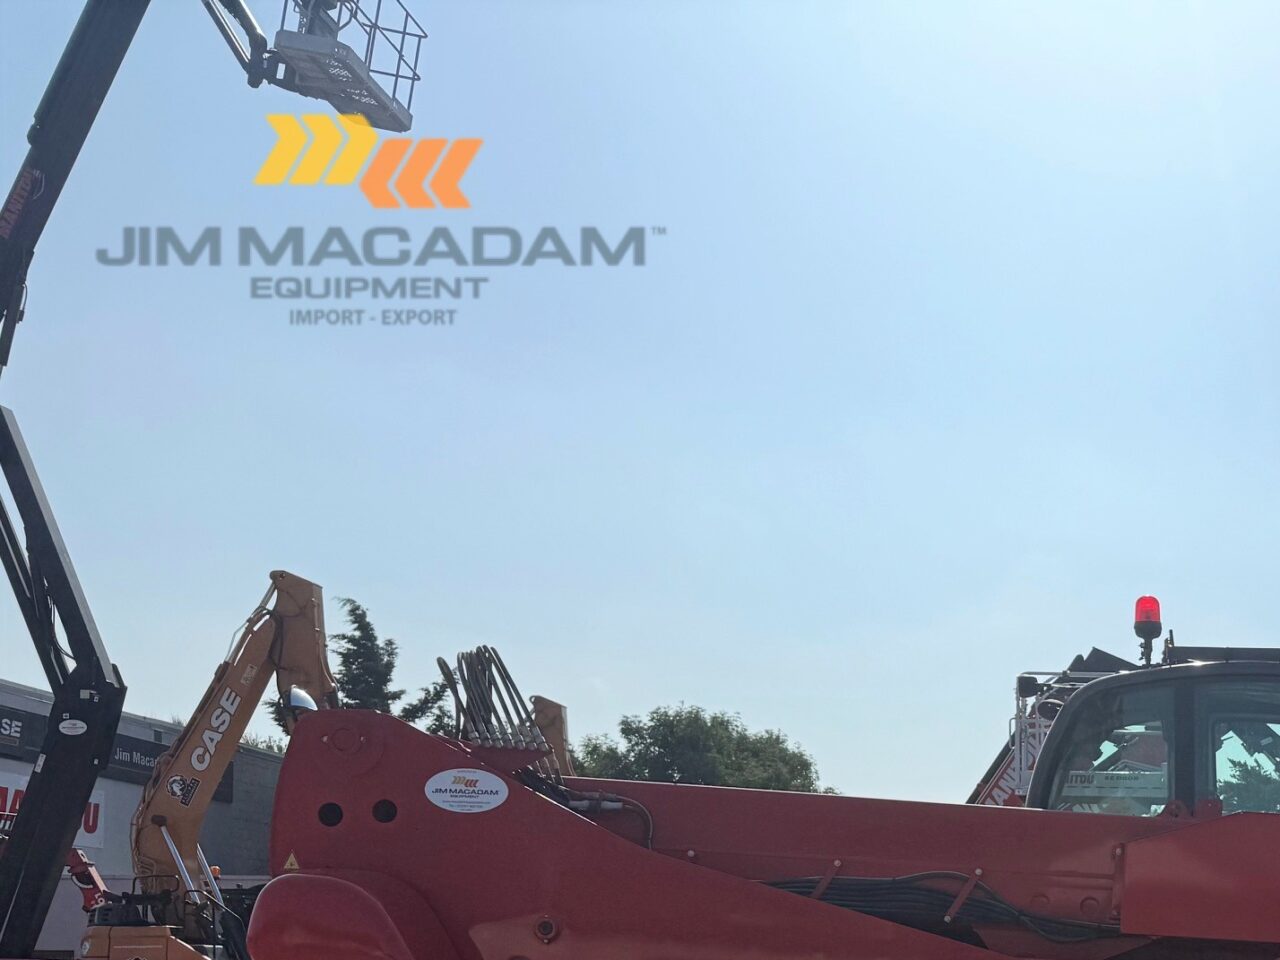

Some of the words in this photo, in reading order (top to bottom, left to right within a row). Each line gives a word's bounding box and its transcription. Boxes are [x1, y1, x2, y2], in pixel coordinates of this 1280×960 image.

[0, 718, 22, 737] SE
[191, 687, 242, 771] CASE
[114, 747, 131, 763] Jim
[132, 751, 156, 768] Maca
[448, 788, 499, 796] MACADAM
